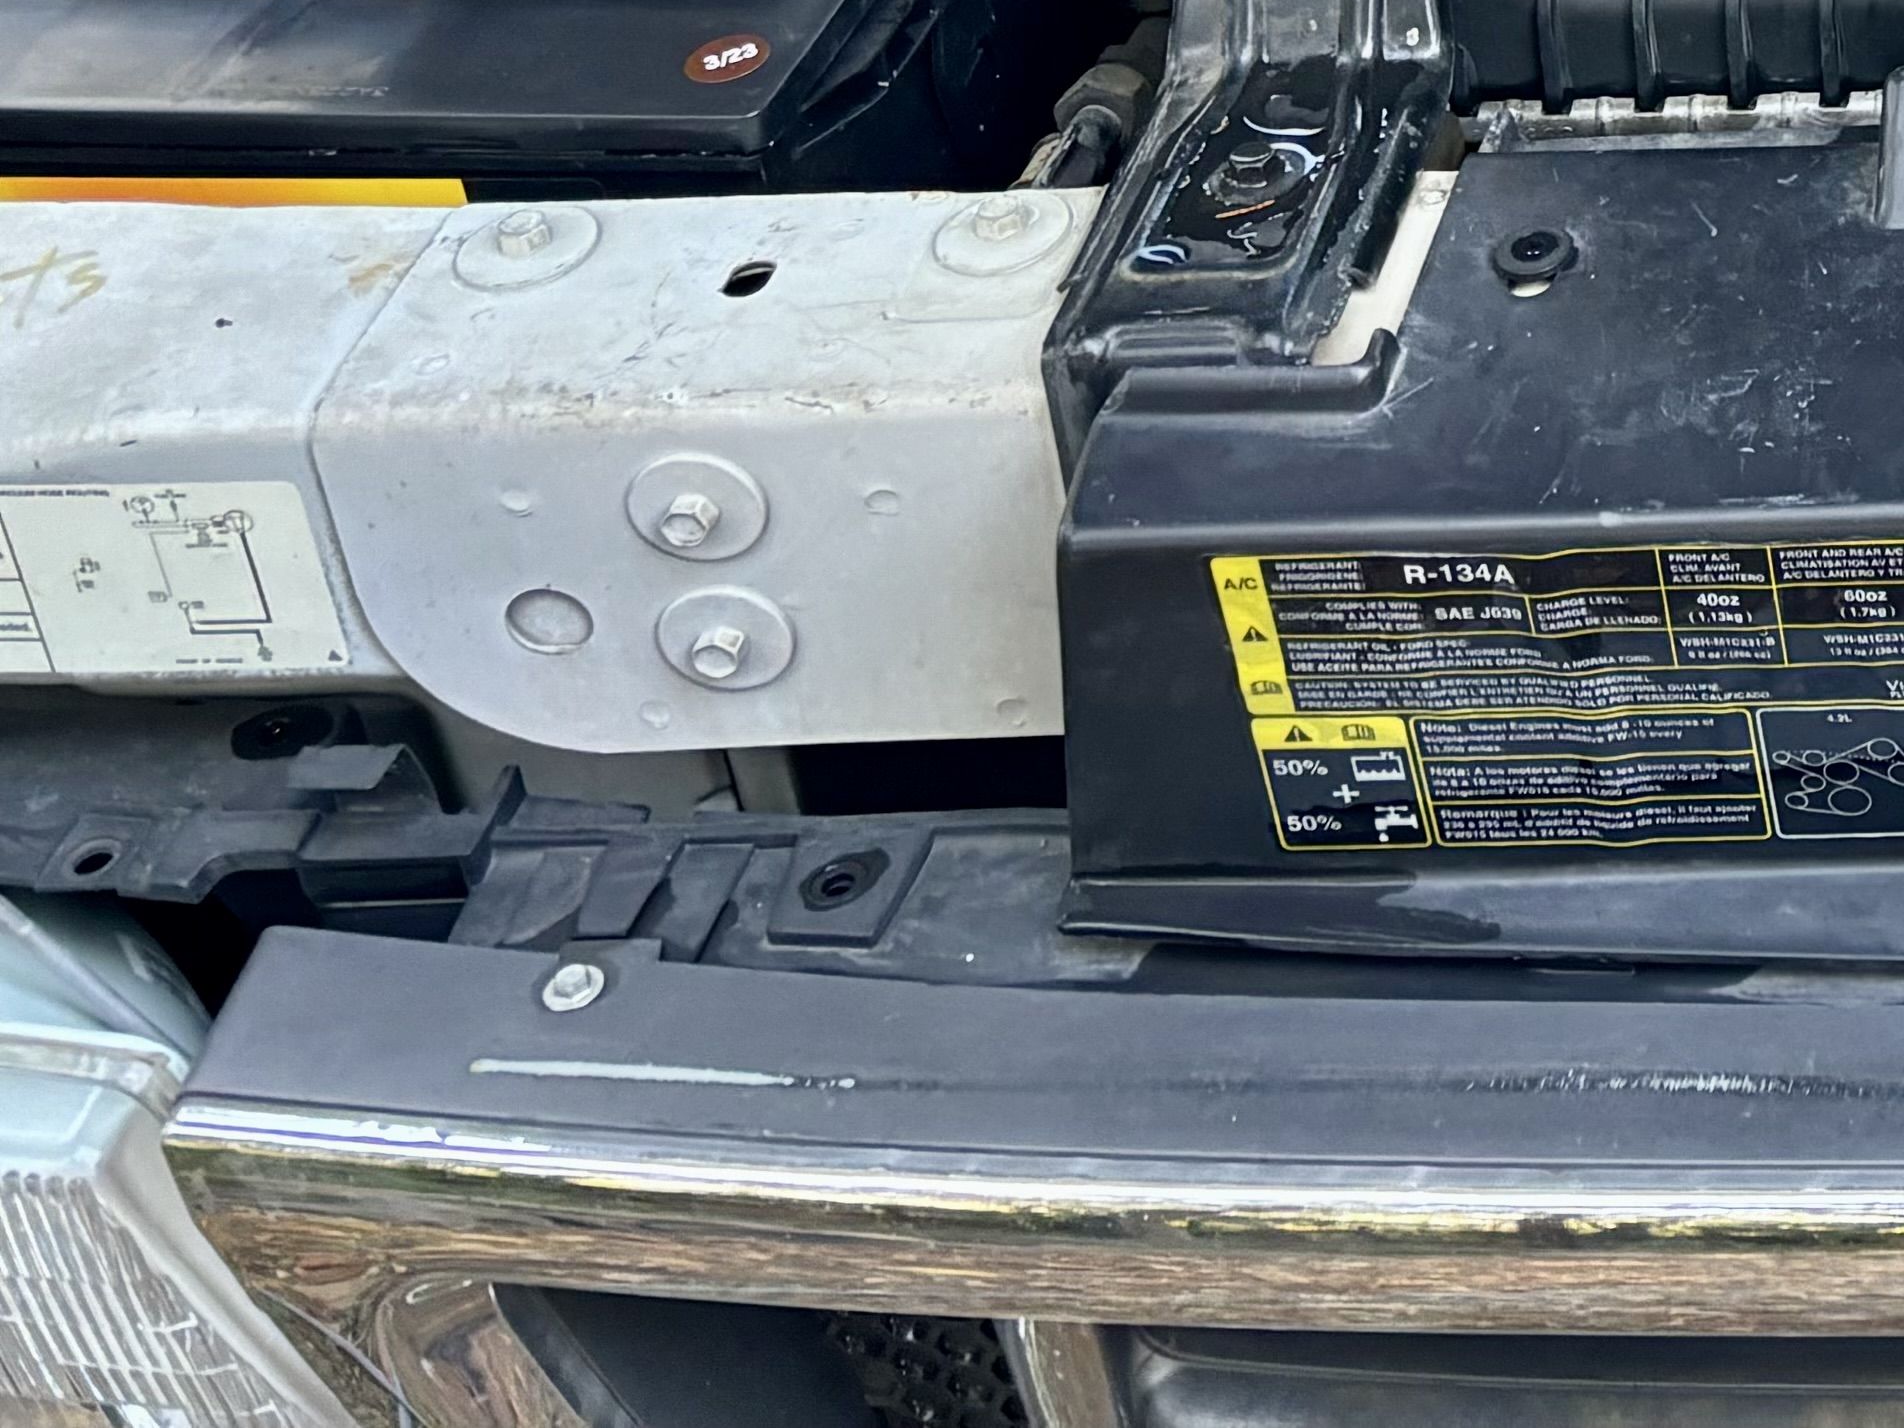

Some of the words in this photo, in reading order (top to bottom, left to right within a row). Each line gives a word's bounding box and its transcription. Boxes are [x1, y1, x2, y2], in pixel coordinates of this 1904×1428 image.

[702, 42, 759, 72] 3/23
[1668, 553, 1707, 563] FRONT
[1710, 553, 1731, 562] A/C
[1779, 550, 1819, 560] FRONT
[1821, 549, 1847, 558] AND
[1848, 548, 1882, 557] REAR
[1883, 547, 1904, 557] A/C
[1704, 563, 1741, 573] AVANT
[1780, 559, 1870, 570] CLIMATISATION
[1888, 558, 1903, 567] ET
[1402, 564, 1516, 585] R-134A
[1671, 574, 1693, 584] A/C
[1694, 573, 1766, 584] DELANTERO
[1783, 570, 1803, 580] A/C
[1804, 569, 1876, 580] DELANTERO
[1223, 577, 1259, 591] A/C
[1696, 593, 1740, 607] 40oz
[1843, 590, 1888, 603] 60oz
[1536, 597, 1587, 612] CHARGE
[1434, 607, 1475, 620] SAE
[1539, 618, 1583, 632] CARGA
[1291, 662, 1316, 672] USE
[1317, 662, 1359, 672] ACEITE
[1272, 759, 1330, 777] 50%
[1286, 815, 1343, 832] 50%
